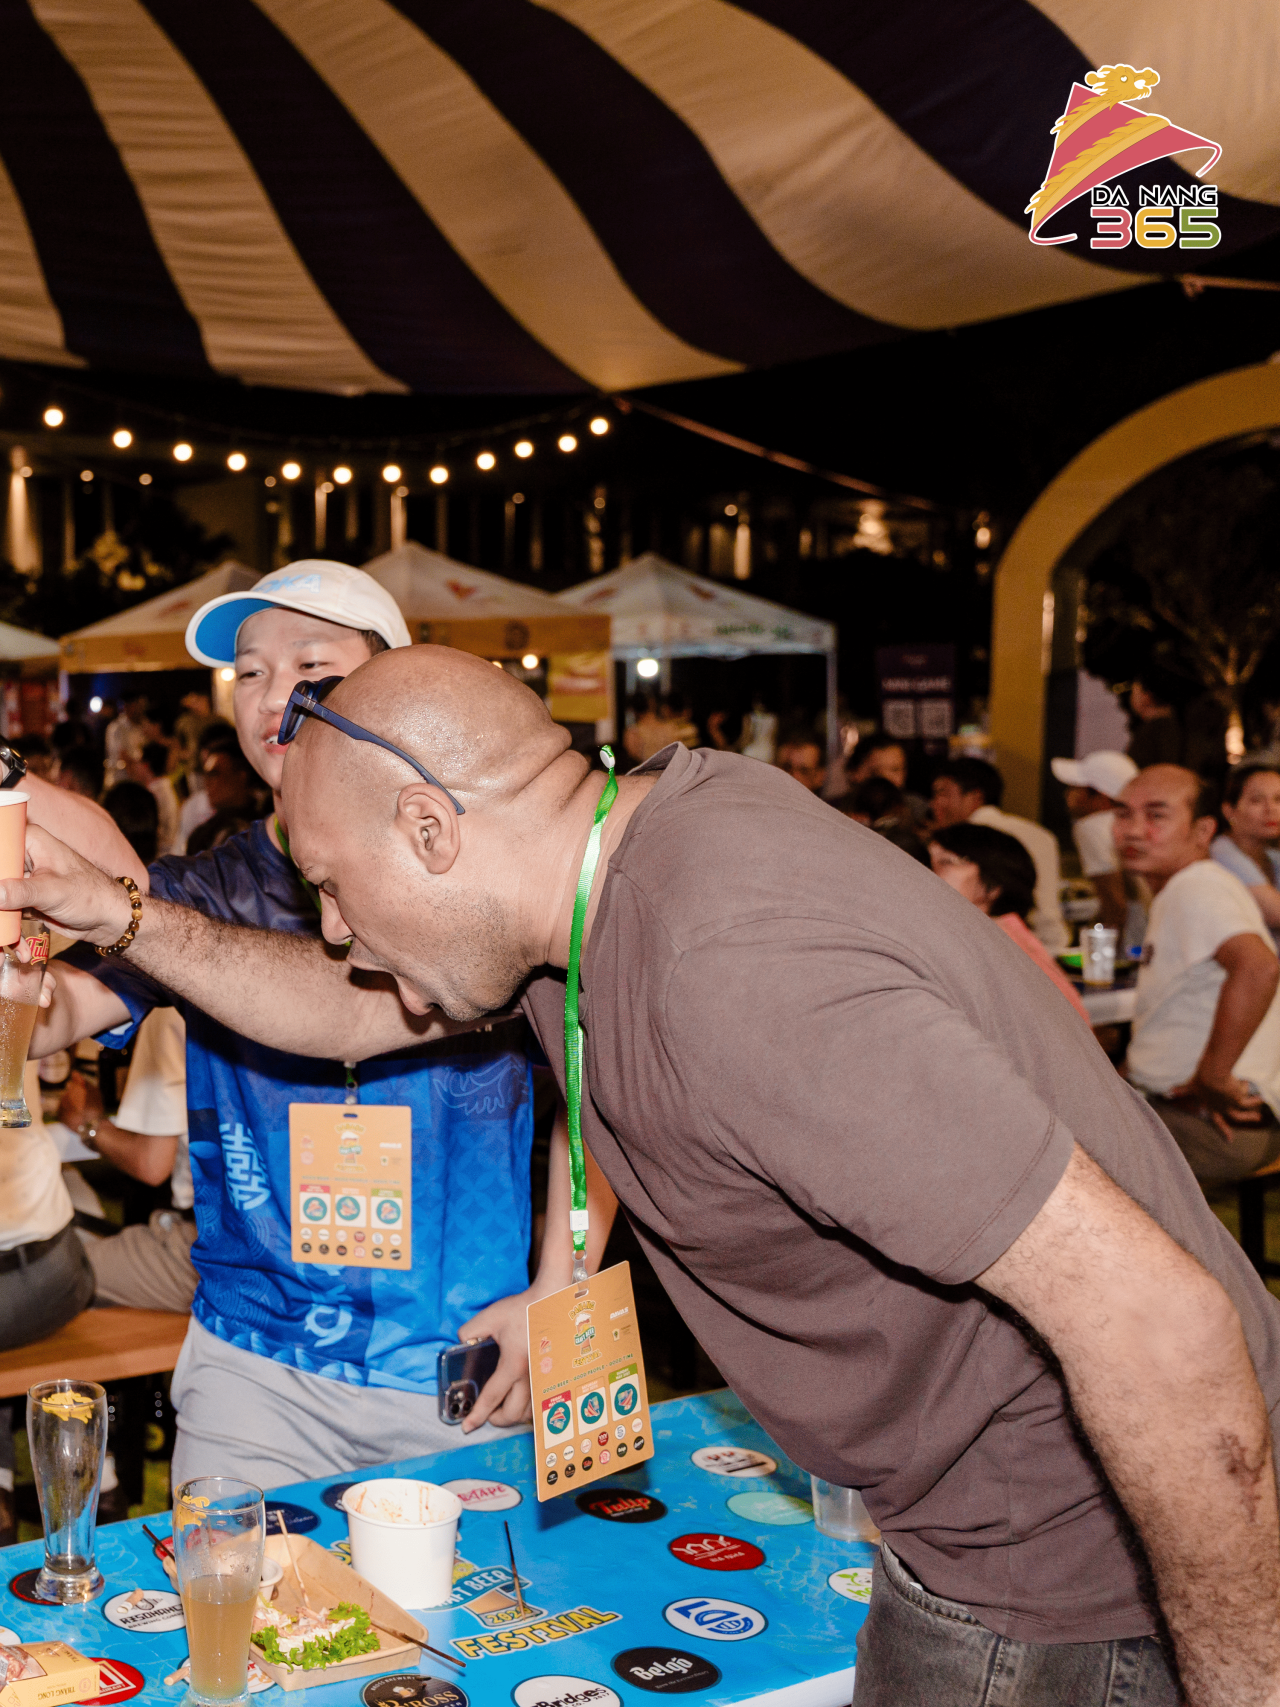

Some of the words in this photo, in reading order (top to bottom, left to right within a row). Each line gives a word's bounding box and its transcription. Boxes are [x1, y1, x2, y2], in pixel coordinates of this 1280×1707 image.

[543, 1385, 556, 1394] GOOD
[557, 1380, 569, 1388] BEER
[573, 1373, 587, 1381] GOOD
[587, 1365, 605, 1375] PEOPLE
[609, 1357, 622, 1366] GOOD
[589, 1497, 651, 1515] Tulip
[463, 1570, 512, 1591] BEER
[119, 1603, 184, 1625] RESONANC
[455, 1607, 619, 1658] FESTIVAL
[629, 1657, 694, 1680] Belgo
[37, 1690, 55, 1700] LONG
[531, 1688, 607, 1707] Bridges
